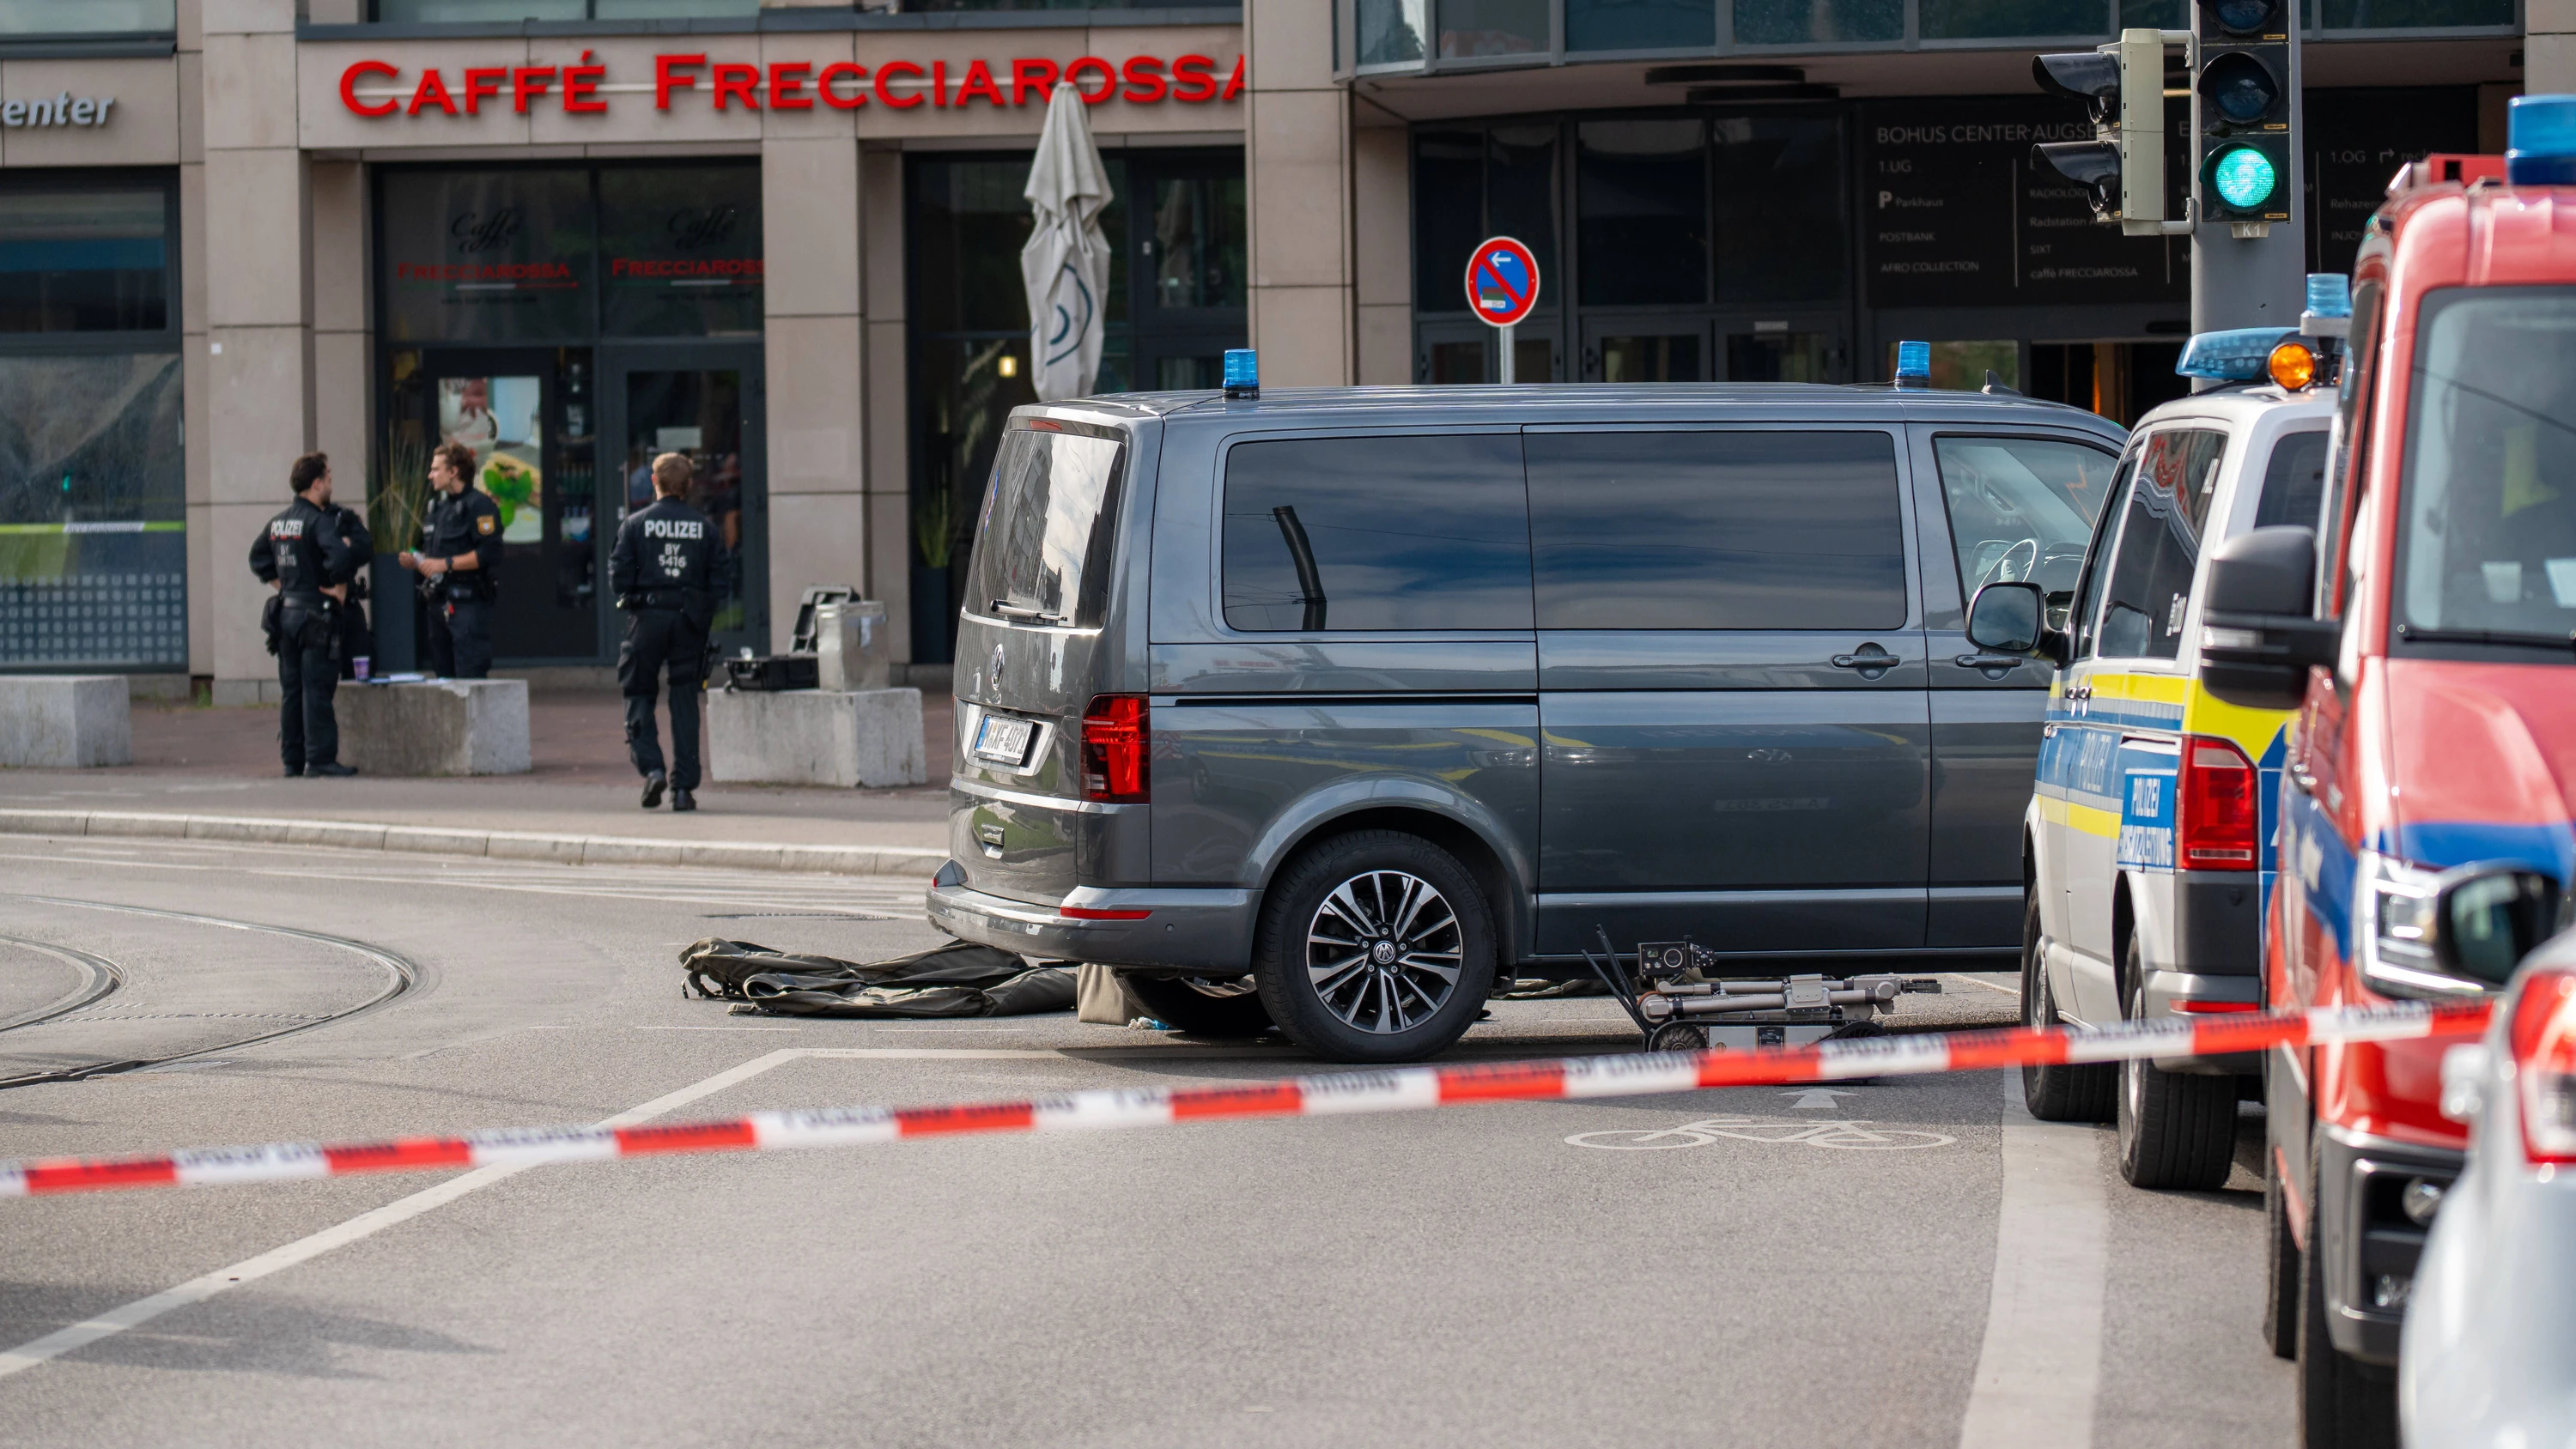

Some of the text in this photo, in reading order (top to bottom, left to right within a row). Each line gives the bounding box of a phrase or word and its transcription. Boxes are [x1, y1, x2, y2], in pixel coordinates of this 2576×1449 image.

[339, 49, 607, 117] CAFFÉ
[0, 89, 116, 128] enter
[1877, 126, 1947, 143] BOHUS
[1951, 124, 2027, 142] CENTER
[2330, 149, 2366, 164] 1.OG
[2029, 188, 2088, 199] RADIOLOGI
[1895, 197, 1944, 209] Parkhaus
[2030, 215, 2087, 228] Radstation
[1879, 232, 1936, 243] POSTBANK
[2242, 223, 2261, 237] K 1
[2030, 244, 2051, 256] SIXT
[398, 261, 571, 282] FRECCIAROSSA
[611, 258, 763, 277] FRECCIAROSS
[1880, 260, 1980, 273] AFRO COLLECTION
[2058, 266, 2138, 278] FRECCIAROSSA
[270, 519, 304, 537] POLIZEI
[644, 519, 703, 539] POLIZEI
[664, 543, 681, 556] BY
[658, 554, 688, 569] 5416
[2130, 777, 2161, 818] POLIZEI
